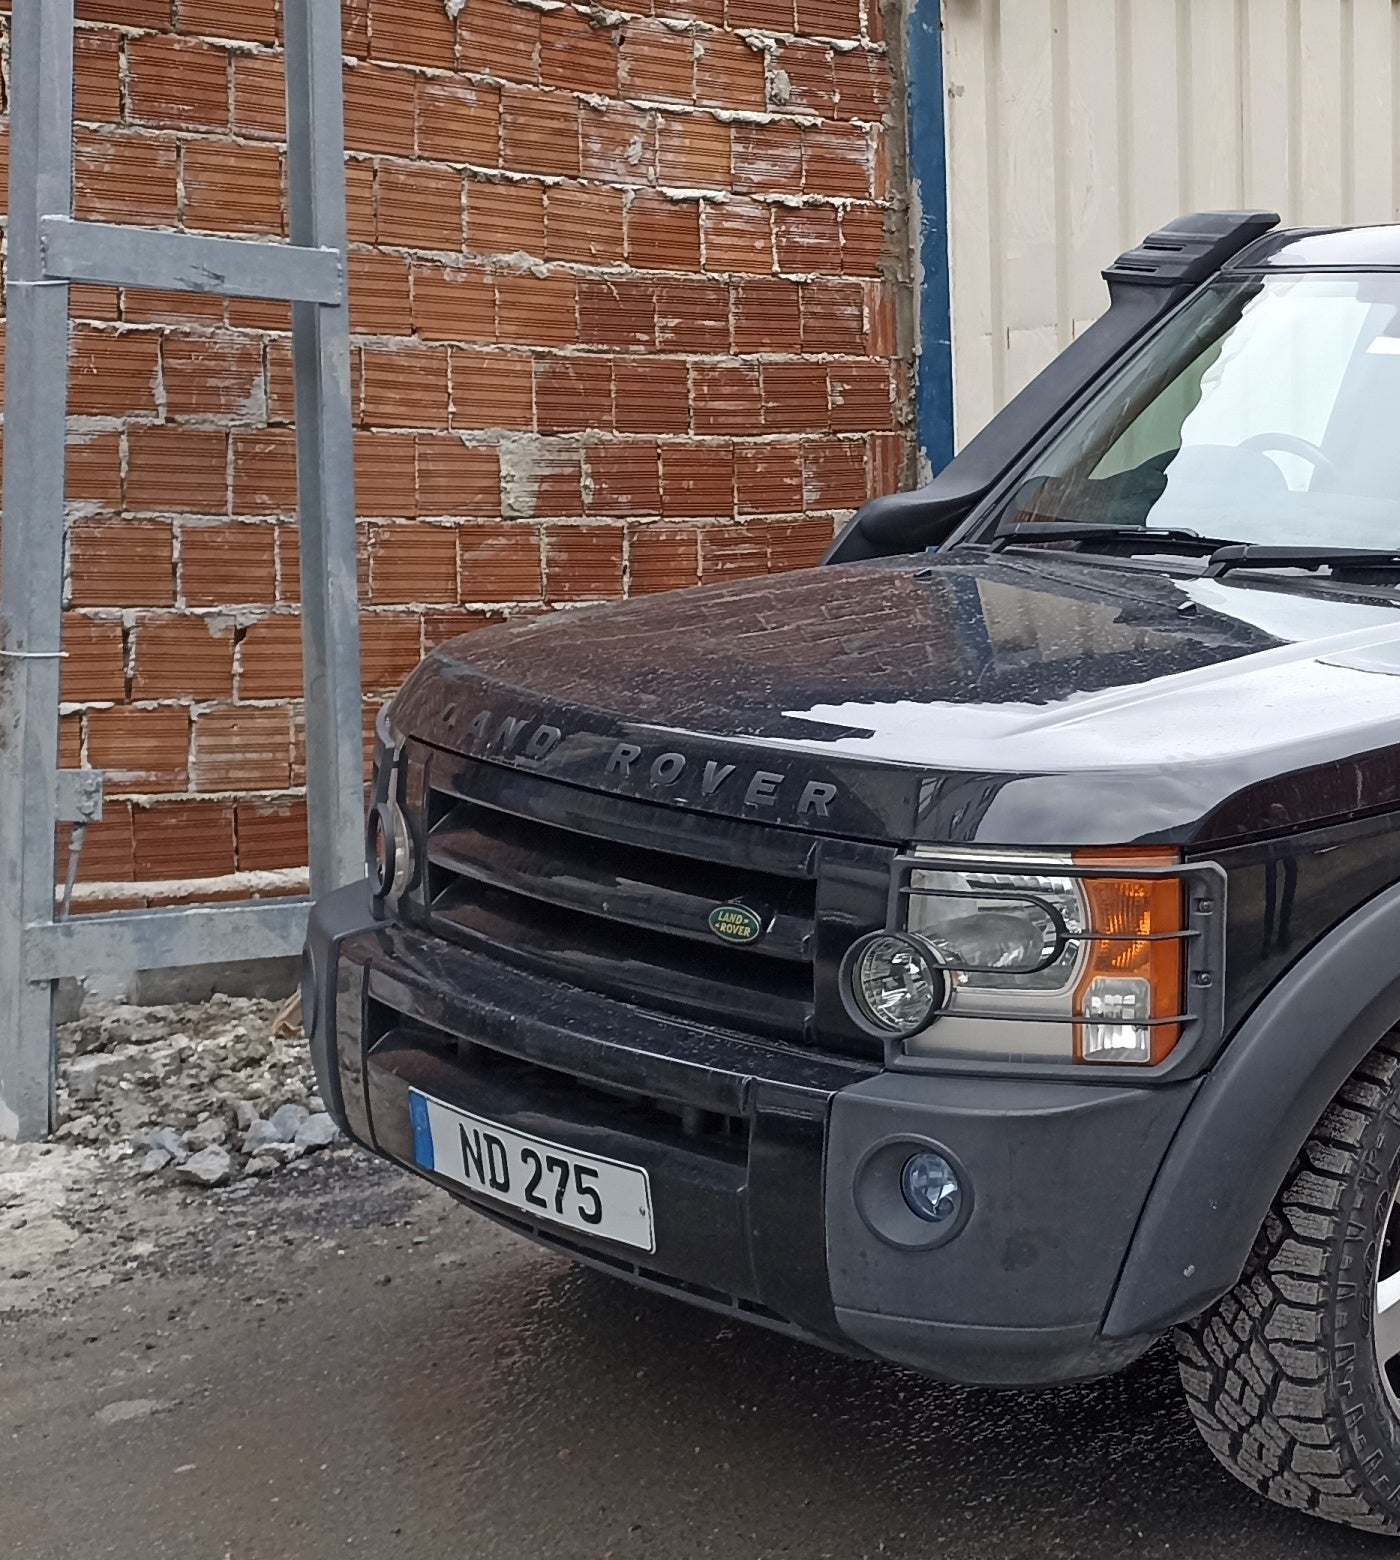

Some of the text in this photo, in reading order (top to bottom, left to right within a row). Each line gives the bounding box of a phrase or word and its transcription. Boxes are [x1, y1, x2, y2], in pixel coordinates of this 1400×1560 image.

[440, 702, 838, 818] LAND ROVER
[717, 910, 743, 925] LAND
[719, 922, 751, 937] ROVER
[458, 1122, 603, 1225] ND 275
